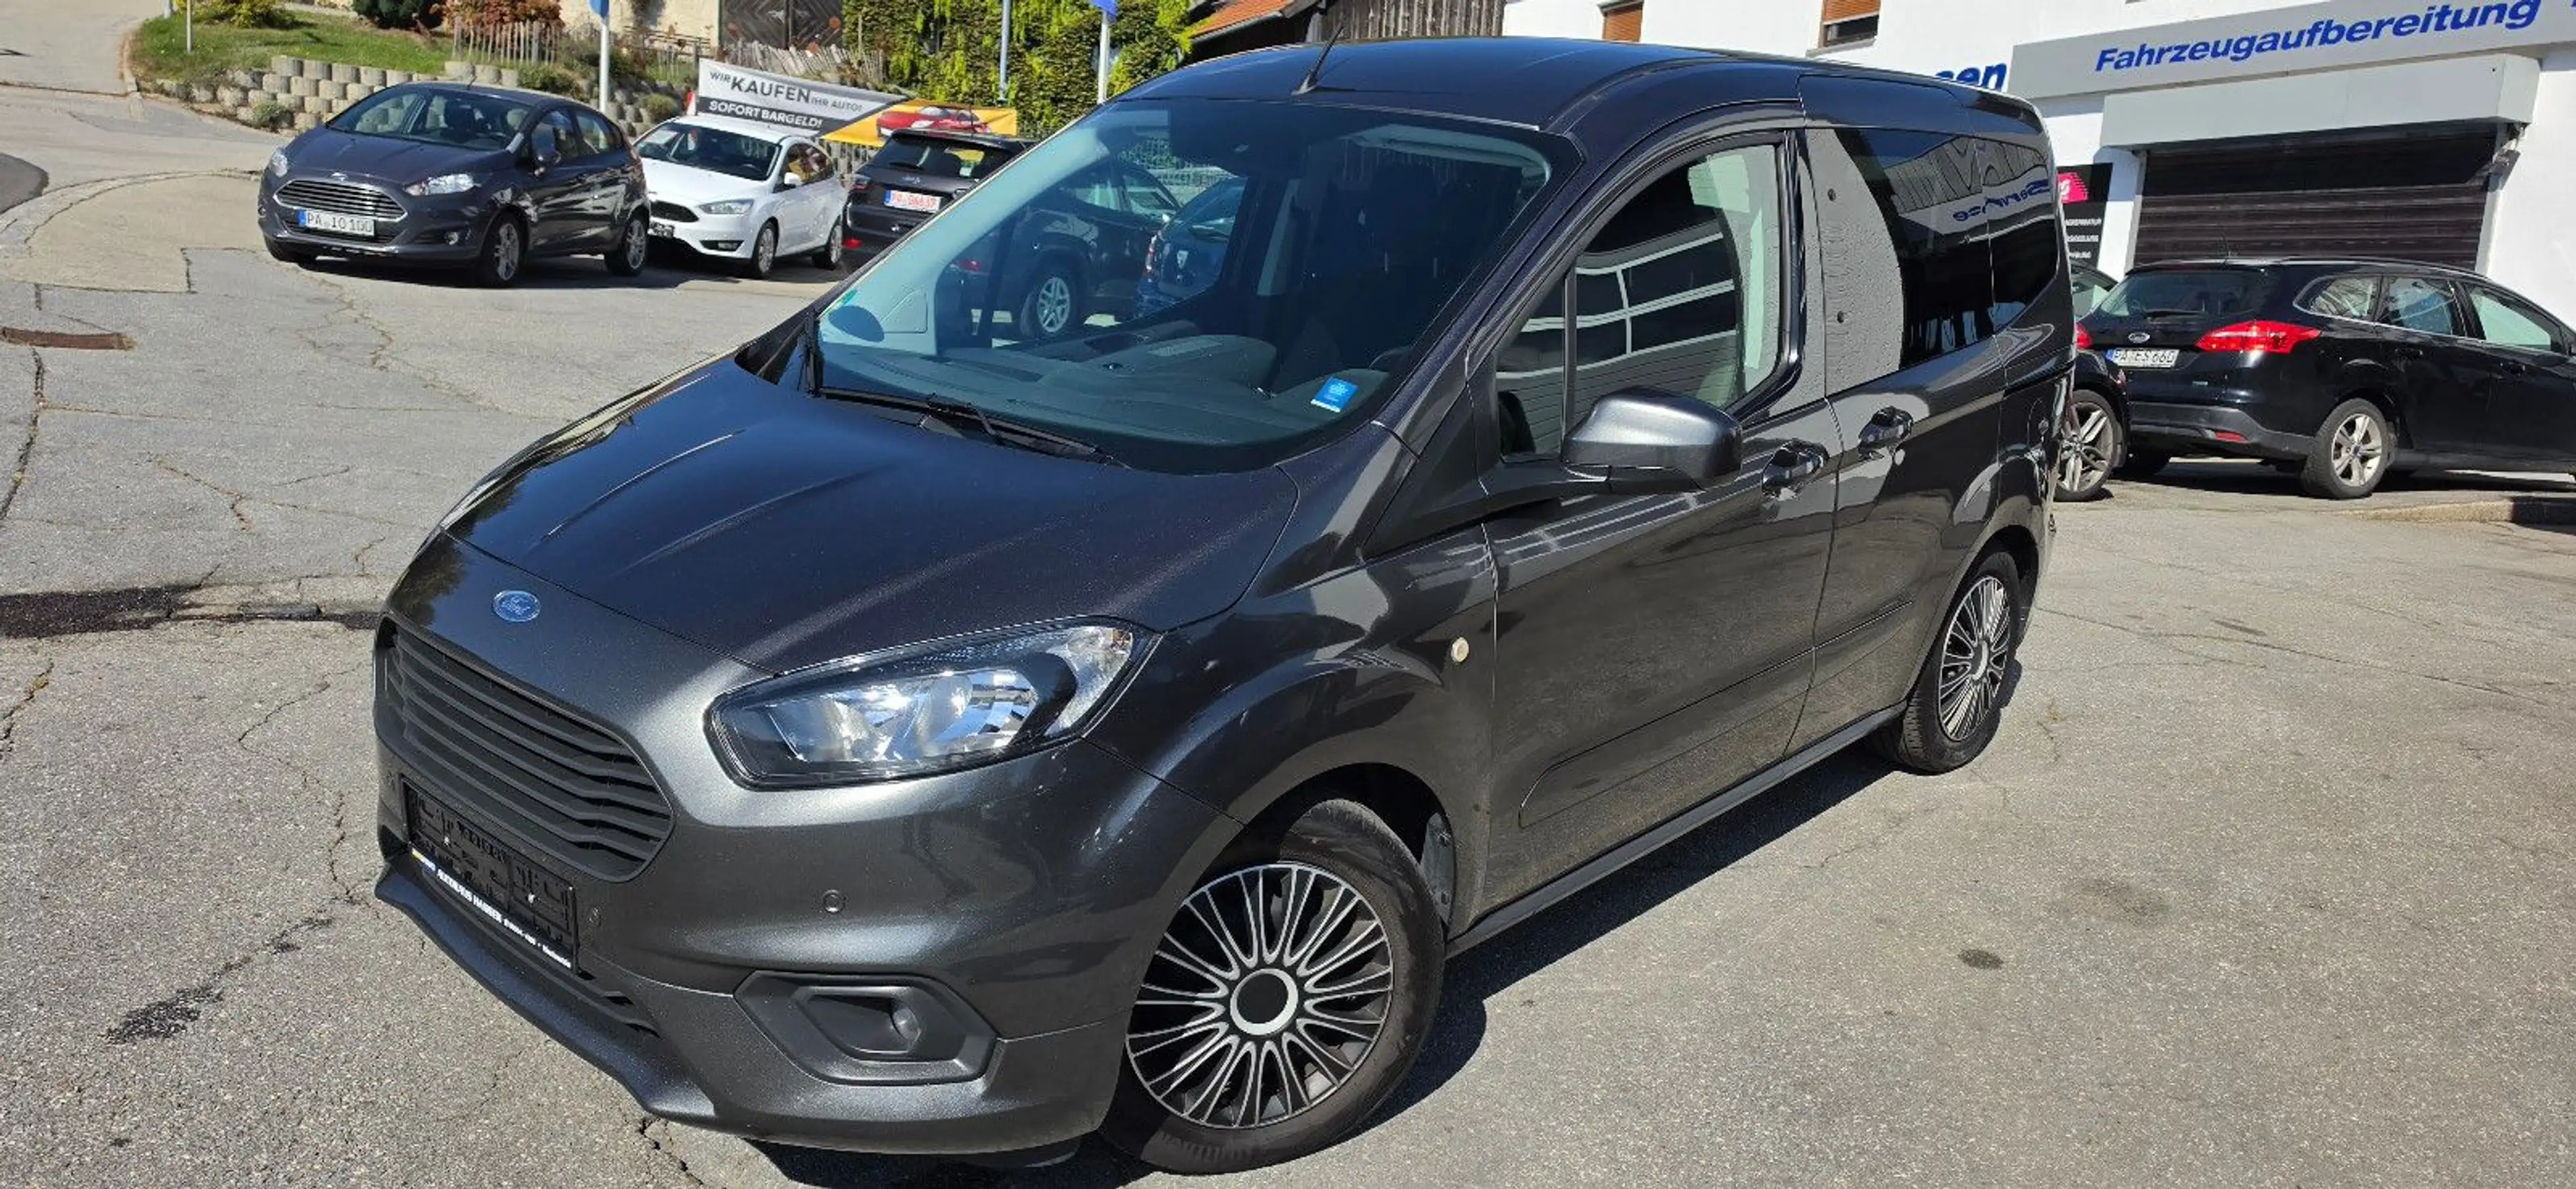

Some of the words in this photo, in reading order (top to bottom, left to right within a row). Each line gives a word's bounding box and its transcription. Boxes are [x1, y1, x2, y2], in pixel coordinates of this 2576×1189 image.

[2095, 0, 2541, 72] Fahrzeugaufbereitung
[709, 71, 731, 82] WIR
[731, 76, 811, 104] KAUFEN
[811, 97, 829, 106] IHR
[708, 101, 761, 117] SOFORT
[761, 109, 823, 128] BARGELD!
[307, 211, 323, 226] PA
